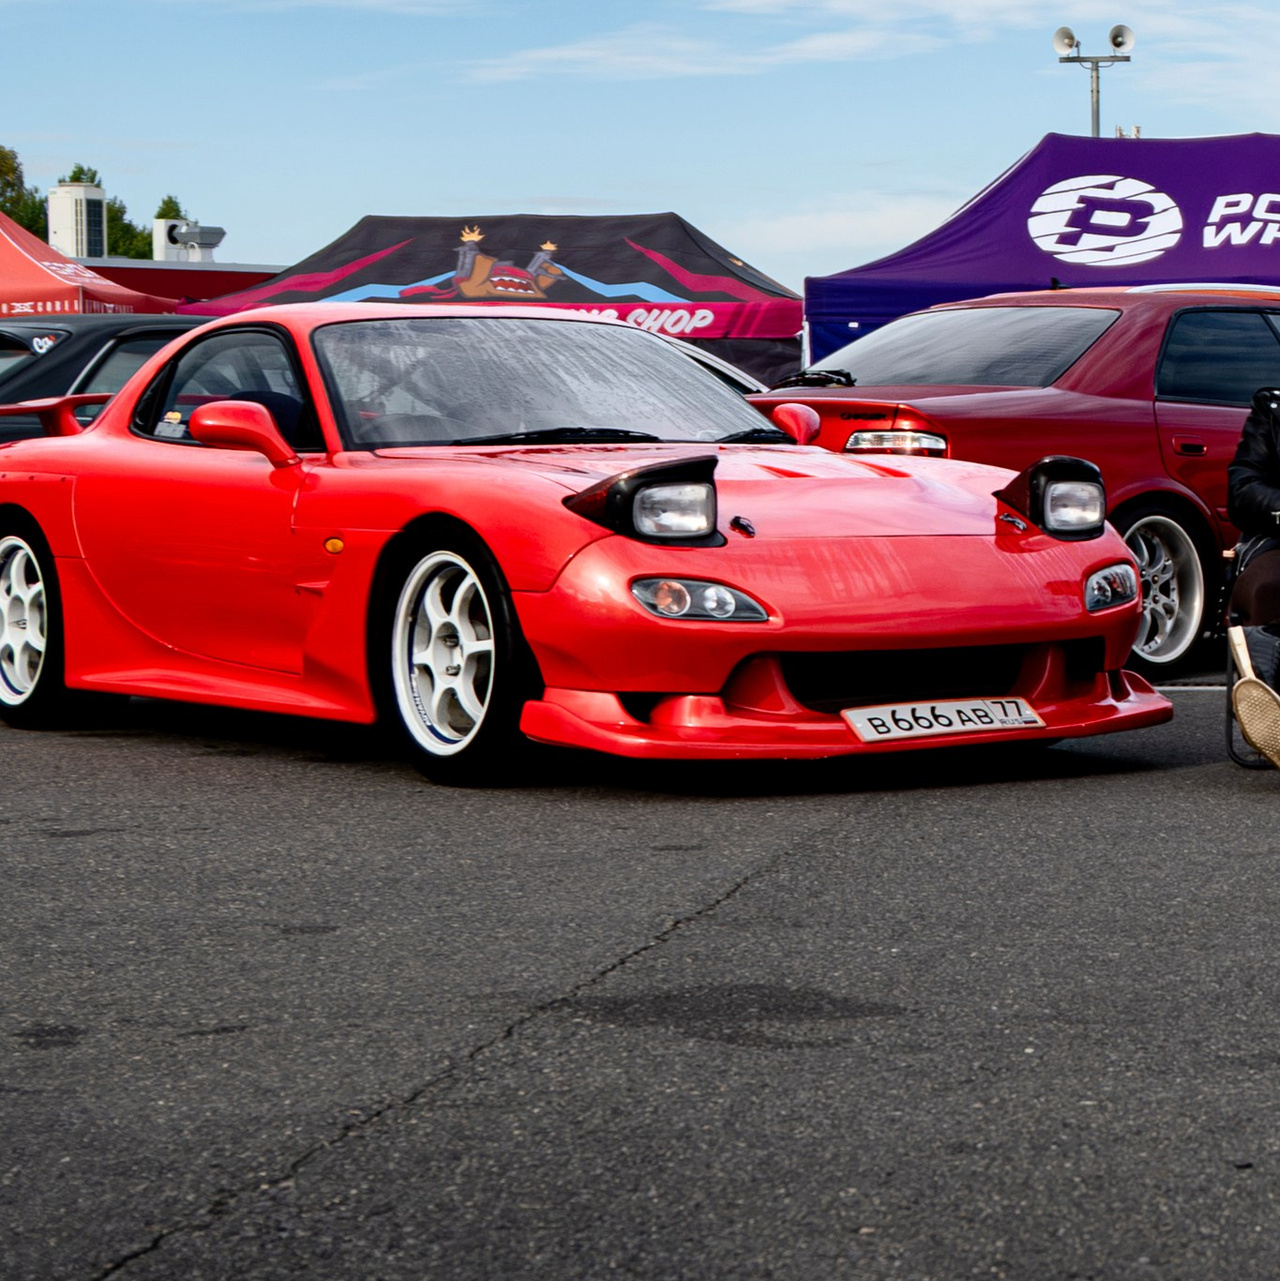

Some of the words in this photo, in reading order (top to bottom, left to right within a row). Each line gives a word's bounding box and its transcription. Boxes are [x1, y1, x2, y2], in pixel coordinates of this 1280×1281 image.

[626, 308, 715, 334] SHOP
[991, 700, 1023, 718] 77
[1000, 718, 1023, 727] RUS
